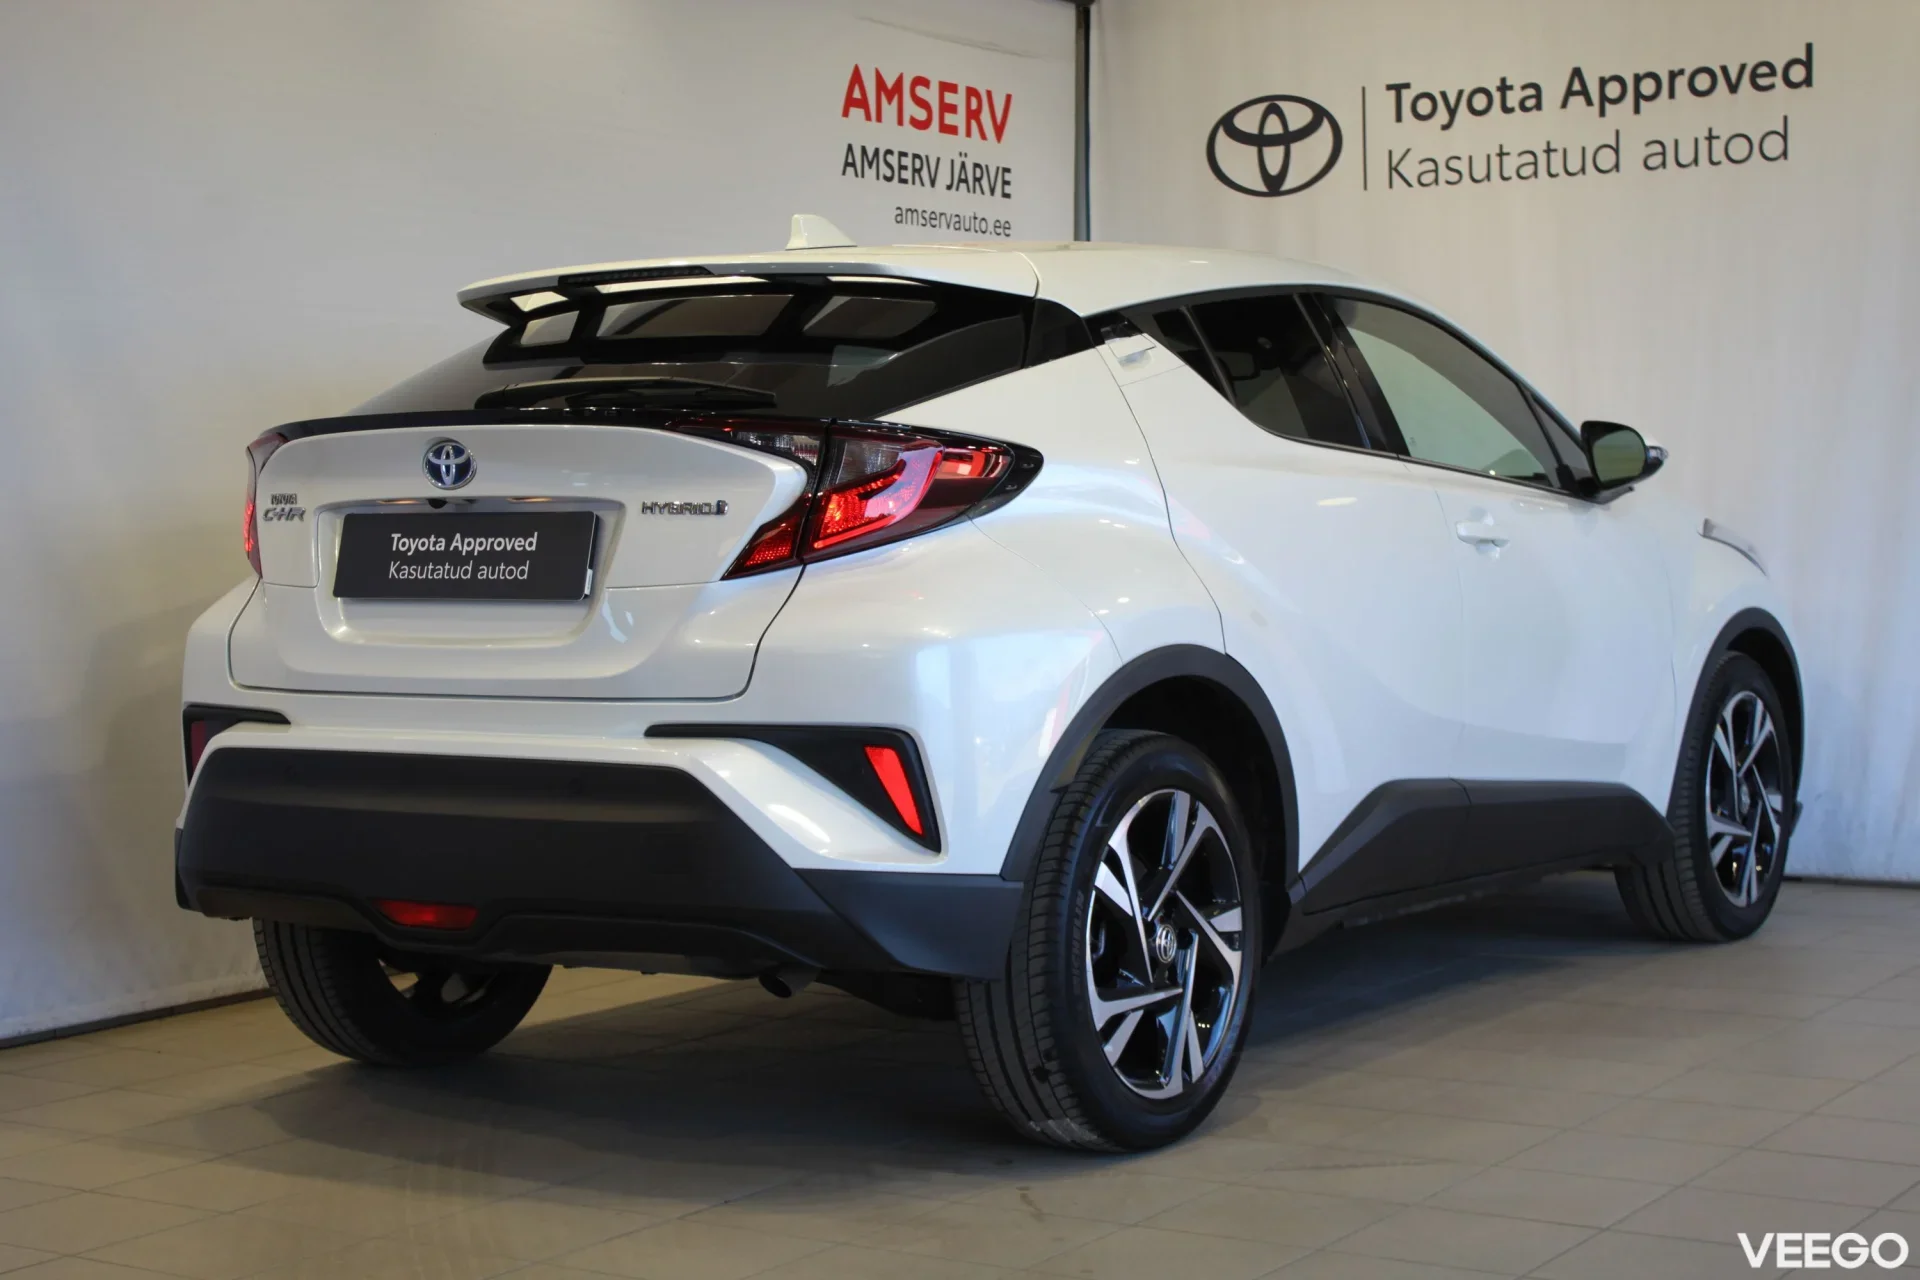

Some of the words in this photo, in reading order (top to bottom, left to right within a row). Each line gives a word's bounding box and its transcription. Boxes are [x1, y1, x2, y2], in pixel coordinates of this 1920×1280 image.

[841, 63, 1012, 144] AMSERV
[1385, 76, 1543, 131] Toyota
[1560, 42, 1813, 118] Approved
[841, 143, 941, 188] AMSERV
[946, 151, 1012, 199] JÄRVE
[1388, 129, 1620, 189] Kasutatud
[1643, 115, 1788, 171] autod
[895, 206, 1012, 238] amservauto.ee
[641, 501, 712, 515] HYBRID
[391, 533, 445, 555] Toyota
[450, 532, 538, 555] Approved
[389, 560, 473, 579] Kasutatud
[477, 560, 529, 580] autod
